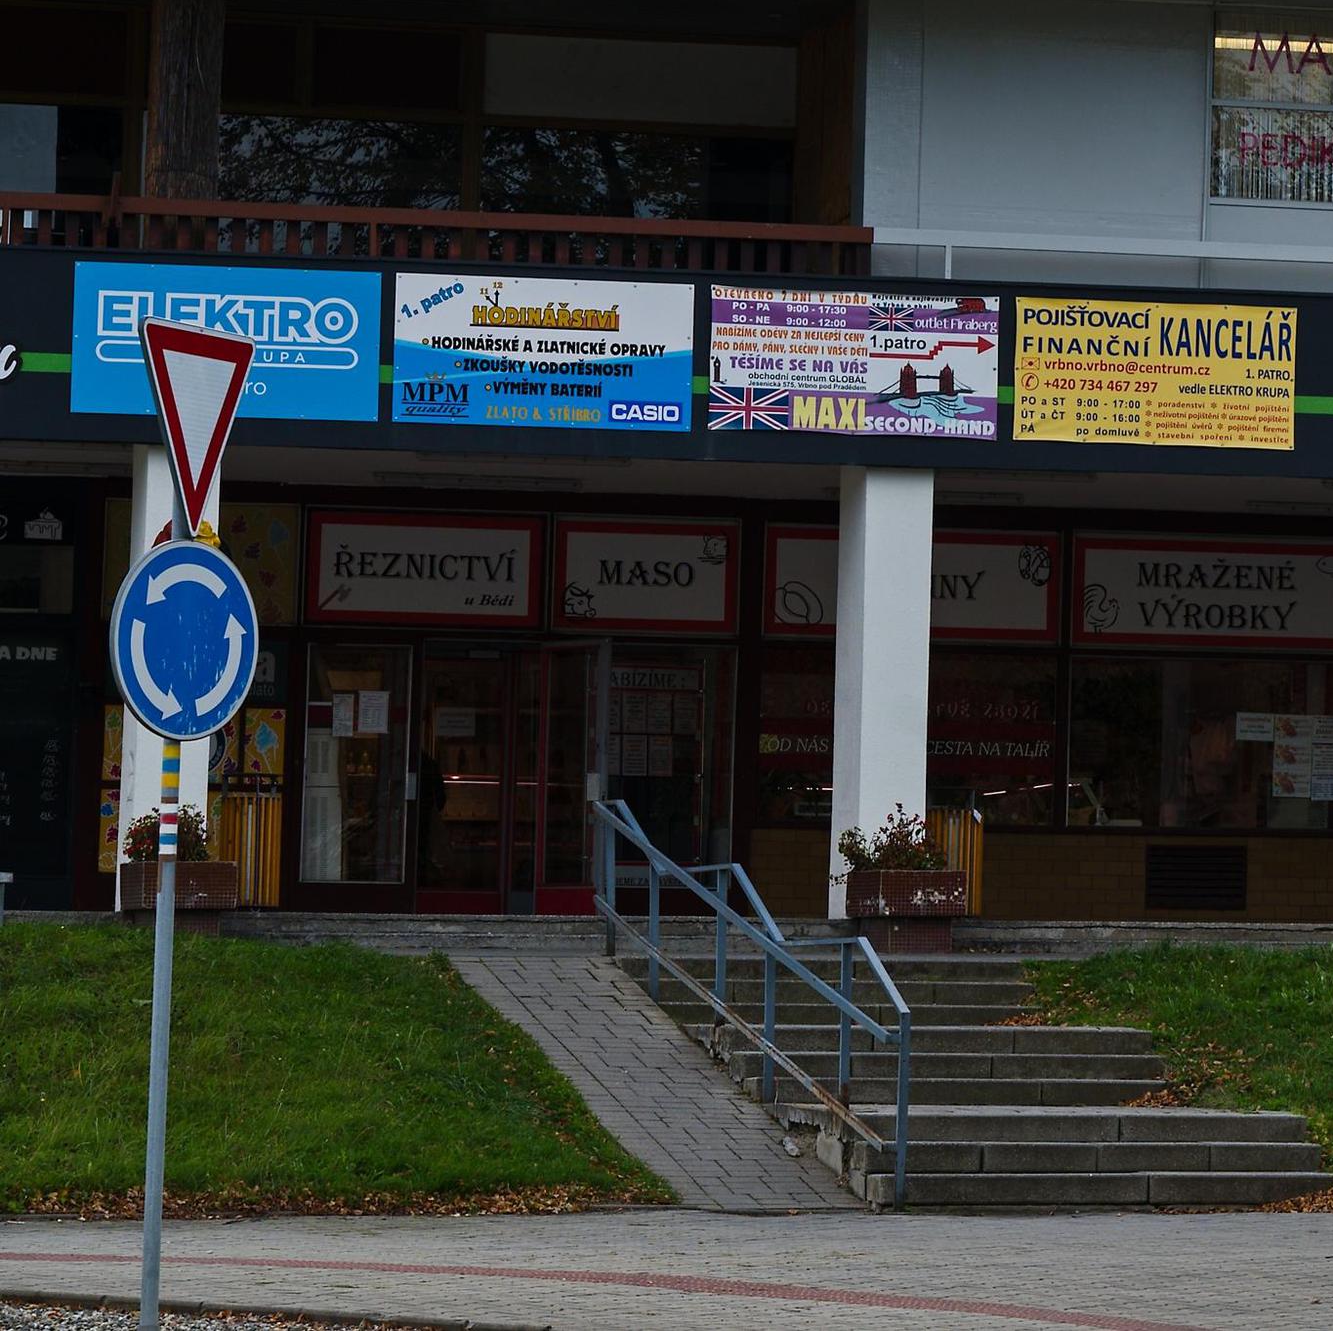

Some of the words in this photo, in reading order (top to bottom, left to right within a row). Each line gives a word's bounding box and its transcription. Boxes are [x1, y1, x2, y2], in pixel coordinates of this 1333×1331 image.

[401, 304, 419, 318] 1.
[420, 282, 465, 313] patro
[782, 290, 787, 301] 7
[819, 293, 825, 303] V
[472, 303, 618, 329] HODINÁŘSTVÍ
[732, 301, 747, 311] PO
[786, 304, 809, 313] 9:00
[818, 305, 846, 315] 17:30
[1023, 305, 1151, 329] POJIŠŤOVACÍ
[732, 315, 747, 323] SO
[756, 315, 770, 324] NE
[786, 318, 809, 326] 9:00
[819, 319, 846, 327] 12:00
[915, 317, 950, 329] outlet
[716, 325, 757, 338] NABÍZÍME
[760, 327, 788, 339] ODĚVY
[791, 330, 801, 340] ZA
[804, 329, 841, 342] NEJLEPŠÍ
[844, 332, 865, 343] CENY
[870, 335, 927, 351] 1.patro
[1160, 310, 1292, 362] KANCELÁŘ
[431, 334, 519, 352] HODINÁŘSKÉ
[523, 343, 532, 353] A
[537, 339, 605, 356] ZLATNICKÉ
[610, 343, 666, 358] OPRAVY
[712, 341, 730, 350] PRO
[732, 340, 759, 353] DÁMY,
[827, 345, 848, 356] VAŠE
[1023, 335, 1151, 357] FINANČNÍ
[464, 357, 525, 373] ZKOUŠKY
[530, 359, 633, 377] VODOTĚSNOSTI
[730, 352, 783, 370] TĚŠÍME
[789, 359, 806, 371] SE
[812, 360, 834, 372] NA
[840, 358, 868, 374] VÁS
[1044, 358, 1211, 376] vrbno.vrbno@centrum.cz
[748, 372, 788, 381] obchodní
[791, 374, 826, 382] centrum
[1245, 369, 1255, 379] 1.
[402, 381, 469, 402] MPM
[494, 378, 547, 396] VÝMĚNY
[551, 381, 602, 398] BATERIÍ
[818, 383, 831, 391] pod
[1044, 378, 1076, 390] +420
[1080, 379, 1103, 391] 734
[1106, 380, 1130, 392] 467
[1134, 381, 1158, 393] 297
[1179, 383, 1206, 395] vedle
[1209, 384, 1253, 397] ELEKTRO
[1256, 386, 1290, 399] KRUPA
[405, 404, 466, 415] quality
[1021, 396, 1037, 405] PO
[1052, 397, 1066, 406] ST
[1076, 398, 1099, 407] 9:00
[1113, 400, 1141, 409] 17:00
[1158, 401, 1205, 409] poradenství
[1223, 401, 1250, 410] životní
[1255, 403, 1290, 413] pojištění
[485, 405, 528, 420] ZLATO
[533, 407, 542, 420] &
[549, 404, 601, 422] STŘÍBRO
[611, 403, 679, 422] CASIO
[793, 396, 866, 430] MAXI
[864, 416, 995, 436] SECOND-HAND
[1021, 408, 1035, 419] ÚT
[1051, 410, 1066, 420] ČT
[1075, 413, 1098, 422] 9:00
[1113, 414, 1140, 423] 16:00
[1020, 422, 1035, 433] PÁ
[1076, 428, 1089, 437] po
[1095, 427, 1140, 437] domluvě
[1156, 421, 1187, 430] pojištění
[1263, 424, 1289, 433] firemní
[1158, 431, 1194, 439] stavební
[1200, 433, 1233, 443] spoření
[1251, 434, 1289, 444] investice
[334, 544, 518, 583] ŘEZNICTVÍ
[599, 559, 694, 588] MASO
[1137, 558, 1296, 591] MRAŽENÉ
[464, 596, 473, 606] u
[1138, 594, 1297, 631] VÝROBKY
[16, 646, 58, 661] DNE
[609, 669, 677, 688] ABÍZÍME
[767, 737, 792, 752] OD
[796, 735, 830, 753] NÁS
[978, 741, 1001, 756] NA
[1005, 739, 1050, 757] TALÍŘ
